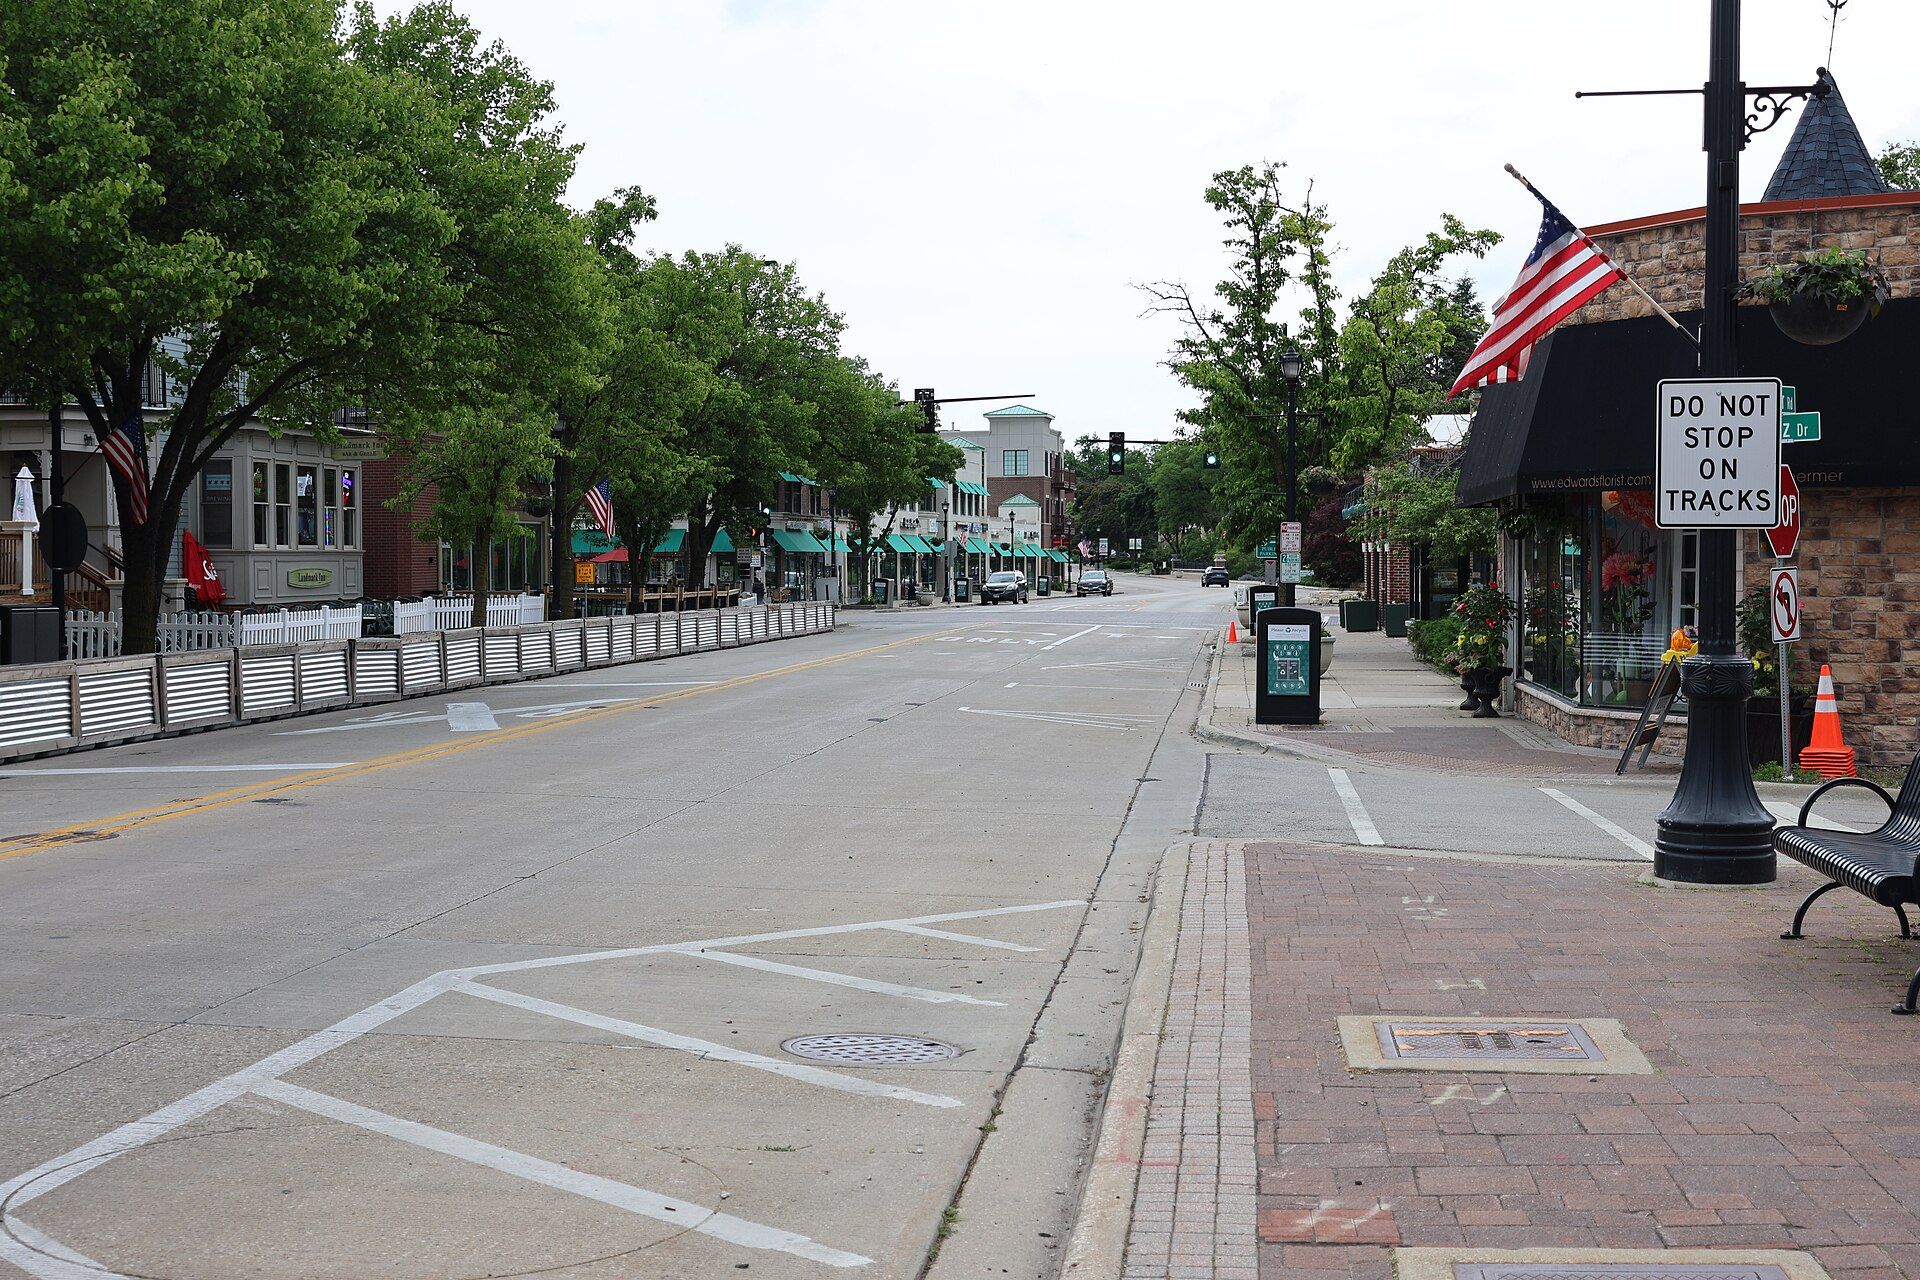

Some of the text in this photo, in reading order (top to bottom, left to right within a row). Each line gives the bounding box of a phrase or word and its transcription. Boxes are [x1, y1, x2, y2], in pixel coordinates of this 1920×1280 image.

[1670, 394, 1770, 417] DO NOT
[1787, 396, 1793, 410] Rd
[1684, 426, 1754, 448] STOP
[1797, 423, 1808, 437] Dr
[1699, 458, 1737, 480] ON
[1792, 471, 1843, 482] ermer
[1531, 474, 1652, 489] www.edwardsflorist.com
[1665, 489, 1771, 511] TRACKS
[935, 636, 1051, 645] ONLY
